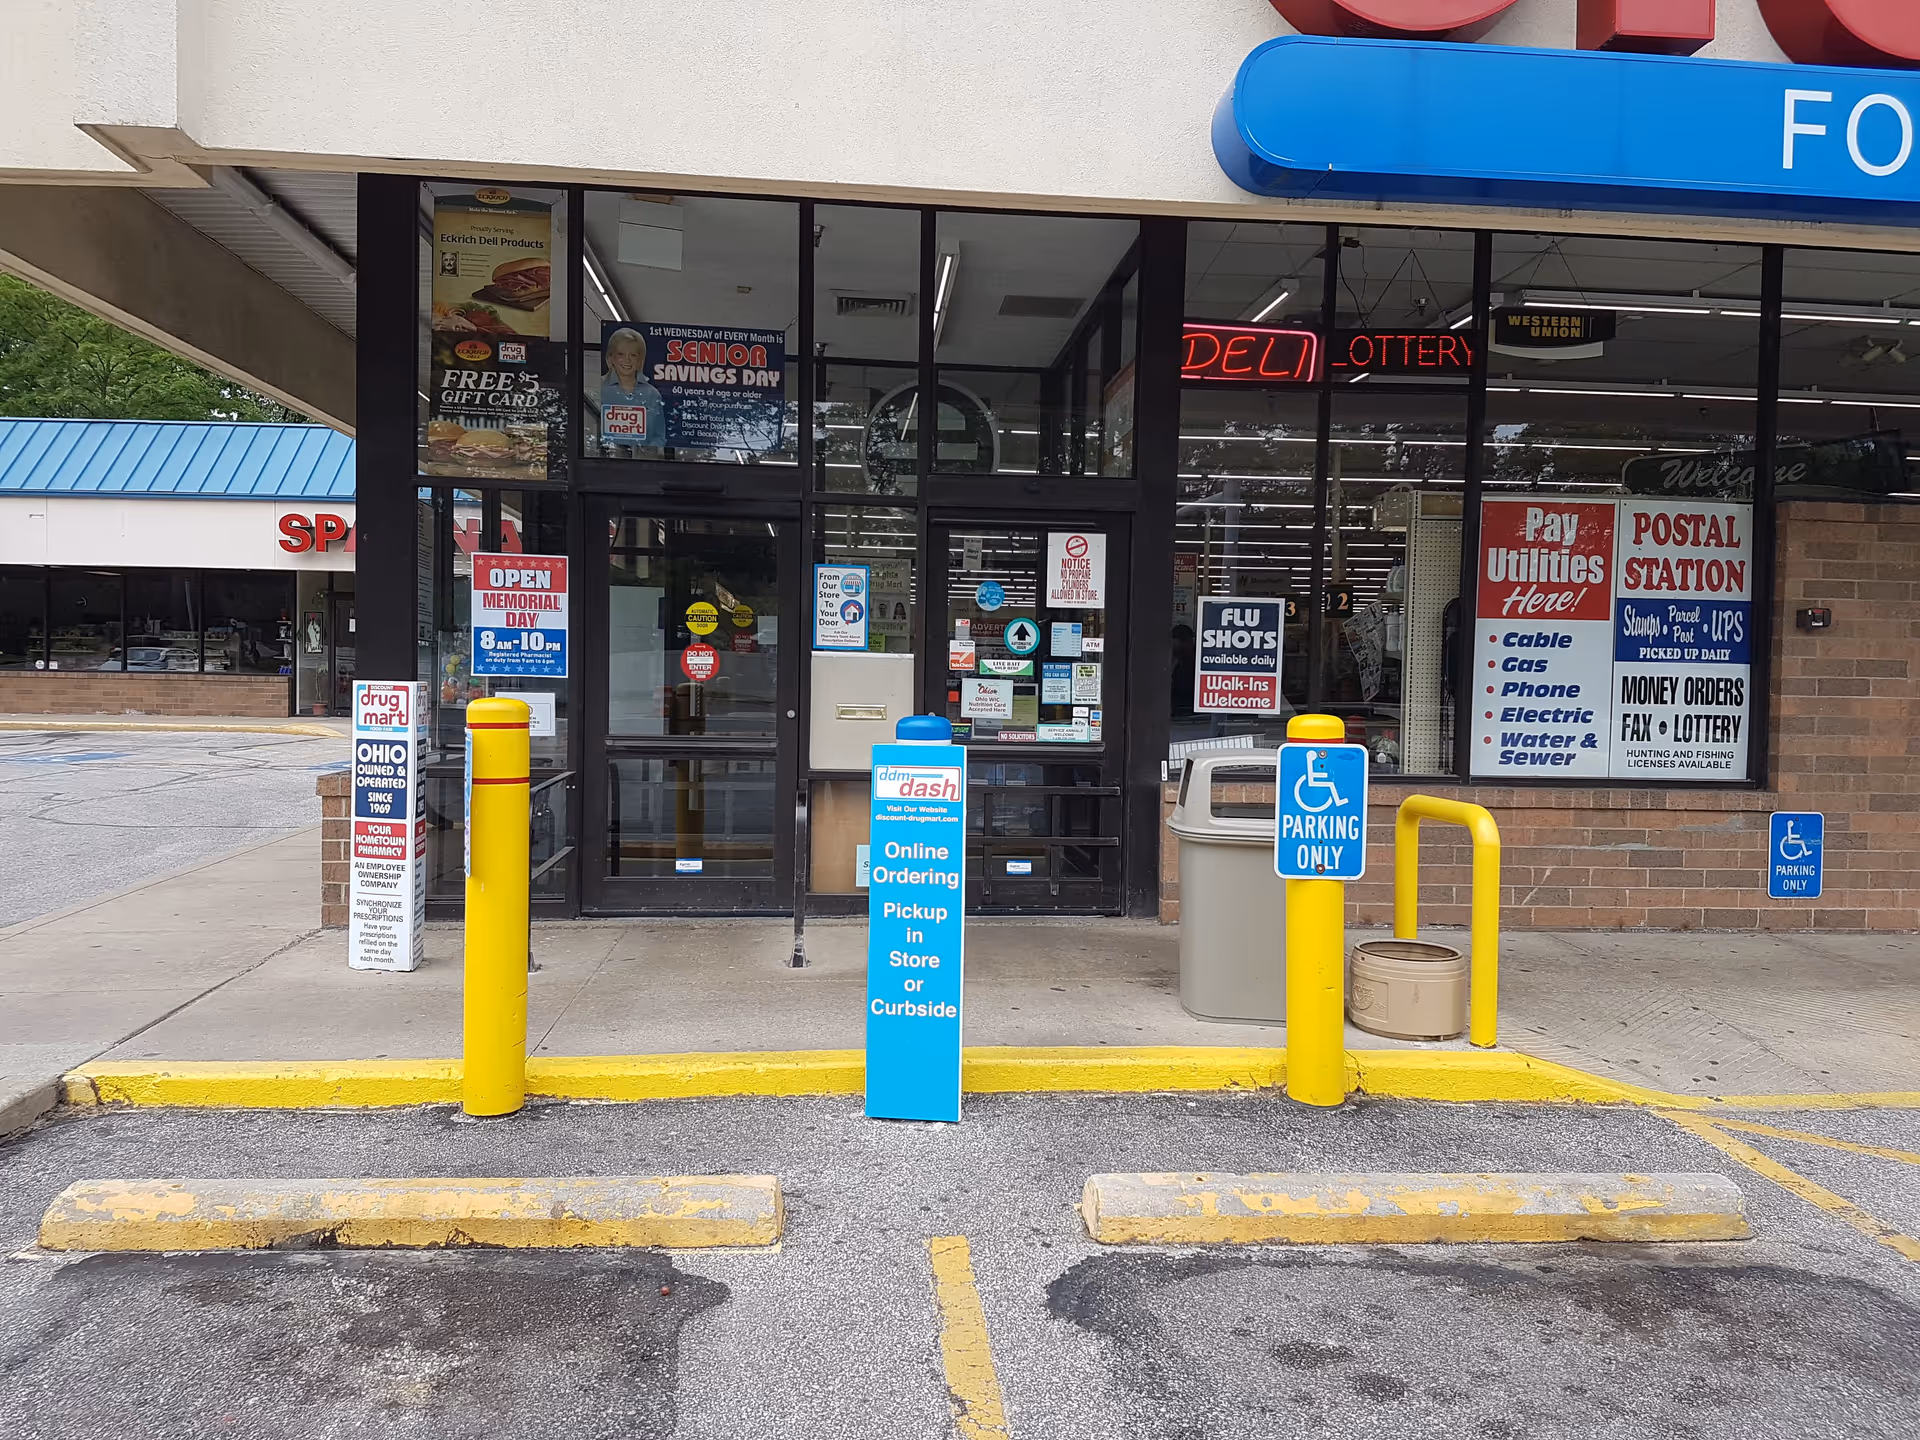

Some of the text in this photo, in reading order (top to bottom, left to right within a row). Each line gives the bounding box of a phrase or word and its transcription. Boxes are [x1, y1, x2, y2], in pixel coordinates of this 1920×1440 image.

[471, 225, 514, 235] Proudly Serving
[441, 233, 544, 248] Eckrich Deli Products
[1508, 315, 1581, 326] WESTERN
[650, 326, 783, 344] 1st WEDNESDAY of EVERY Month is
[1531, 327, 1581, 337] UNION
[501, 344, 521, 355] drug
[667, 339, 767, 368] SENIOR
[1181, 332, 1308, 378] DELI
[1331, 335, 1472, 366] OTTERY
[441, 369, 540, 393] FREE $5
[654, 363, 780, 387] SAVINGS DAY
[441, 390, 538, 407] GIFT CARD
[672, 386, 682, 394] 60
[684, 388, 705, 398] years
[706, 388, 715, 396] of
[716, 390, 731, 399] age
[742, 390, 762, 399] older
[606, 410, 638, 422] drug
[609, 423, 645, 434] mart
[682, 421, 709, 429] Discount
[1525, 507, 1579, 546] Pay
[1632, 512, 1741, 548] POSTAL
[1061, 558, 1091, 569] NOTICE
[1487, 547, 1604, 584] Utilities
[489, 568, 551, 589] OPEN
[820, 572, 840, 580] From
[1061, 569, 1091, 579] NO PROPANE
[1624, 557, 1746, 593] STATION
[1062, 579, 1089, 590] CYLINDERS
[483, 593, 561, 610] MEMORIAL
[1051, 589, 1080, 600] ALLOWED IN
[1337, 592, 1349, 610] 2
[1502, 584, 1587, 616] Here!
[1285, 601, 1296, 616] 3
[505, 612, 538, 628] DAY
[1221, 608, 1260, 627] FLU
[1624, 604, 1744, 644] Stamps Parcel Post UPS
[1203, 629, 1277, 649] SHOTS
[1502, 631, 1573, 649] Cable
[1202, 654, 1275, 667] available daily
[1639, 647, 1731, 661] PICKED UP DAILY
[1501, 657, 1548, 673] Gas
[978, 686, 994, 694] Ohio
[1206, 676, 1269, 691] Walk-Ins
[1500, 681, 1580, 698] Phone
[1621, 675, 1744, 707] MONEY ORDERS
[360, 685, 399, 712] drug
[1203, 692, 1271, 708] Welcome
[364, 710, 409, 726] mart
[1500, 707, 1594, 724] Electric
[1621, 713, 1741, 743] FAX LOTTERY
[1500, 732, 1598, 749] Water &
[357, 743, 406, 764] OHIO
[1498, 750, 1576, 766] Sewer
[1626, 750, 1734, 760] HUNTING AND FISHING
[357, 764, 406, 777] OWNED &
[1627, 759, 1731, 769] LICENSES AVAILABLE
[879, 768, 910, 781] ddm
[357, 777, 406, 789] OPERATED
[899, 778, 959, 800] dash
[368, 792, 393, 803] SINCE
[370, 803, 391, 815] 1969
[876, 814, 958, 823] discount-drugmart.com
[368, 825, 391, 835] YOUR
[1282, 815, 1359, 840] PARKING
[356, 835, 405, 846] HOMETOWN
[358, 846, 402, 857] PHARMACY
[885, 841, 949, 860] Online
[1297, 844, 1344, 870] ONLY
[366, 863, 406, 871] EMPLOYEE
[1776, 865, 1815, 876] PARKING
[358, 871, 401, 880] OWNERSHIP
[873, 866, 959, 890] Ordering
[360, 880, 398, 889] COMPANY
[1783, 880, 1807, 890] ONLY
[356, 899, 402, 908] SYNCHRONIZE
[353, 913, 404, 922] PRESCRIPTIONS
[884, 902, 948, 924] Pickup
[360, 931, 397, 939] prescriptions
[906, 927, 923, 943] in
[380, 948, 391, 956] day
[889, 950, 940, 968] Store
[374, 956, 396, 964] month.
[904, 979, 924, 992] or
[871, 998, 957, 1018] Curbside
